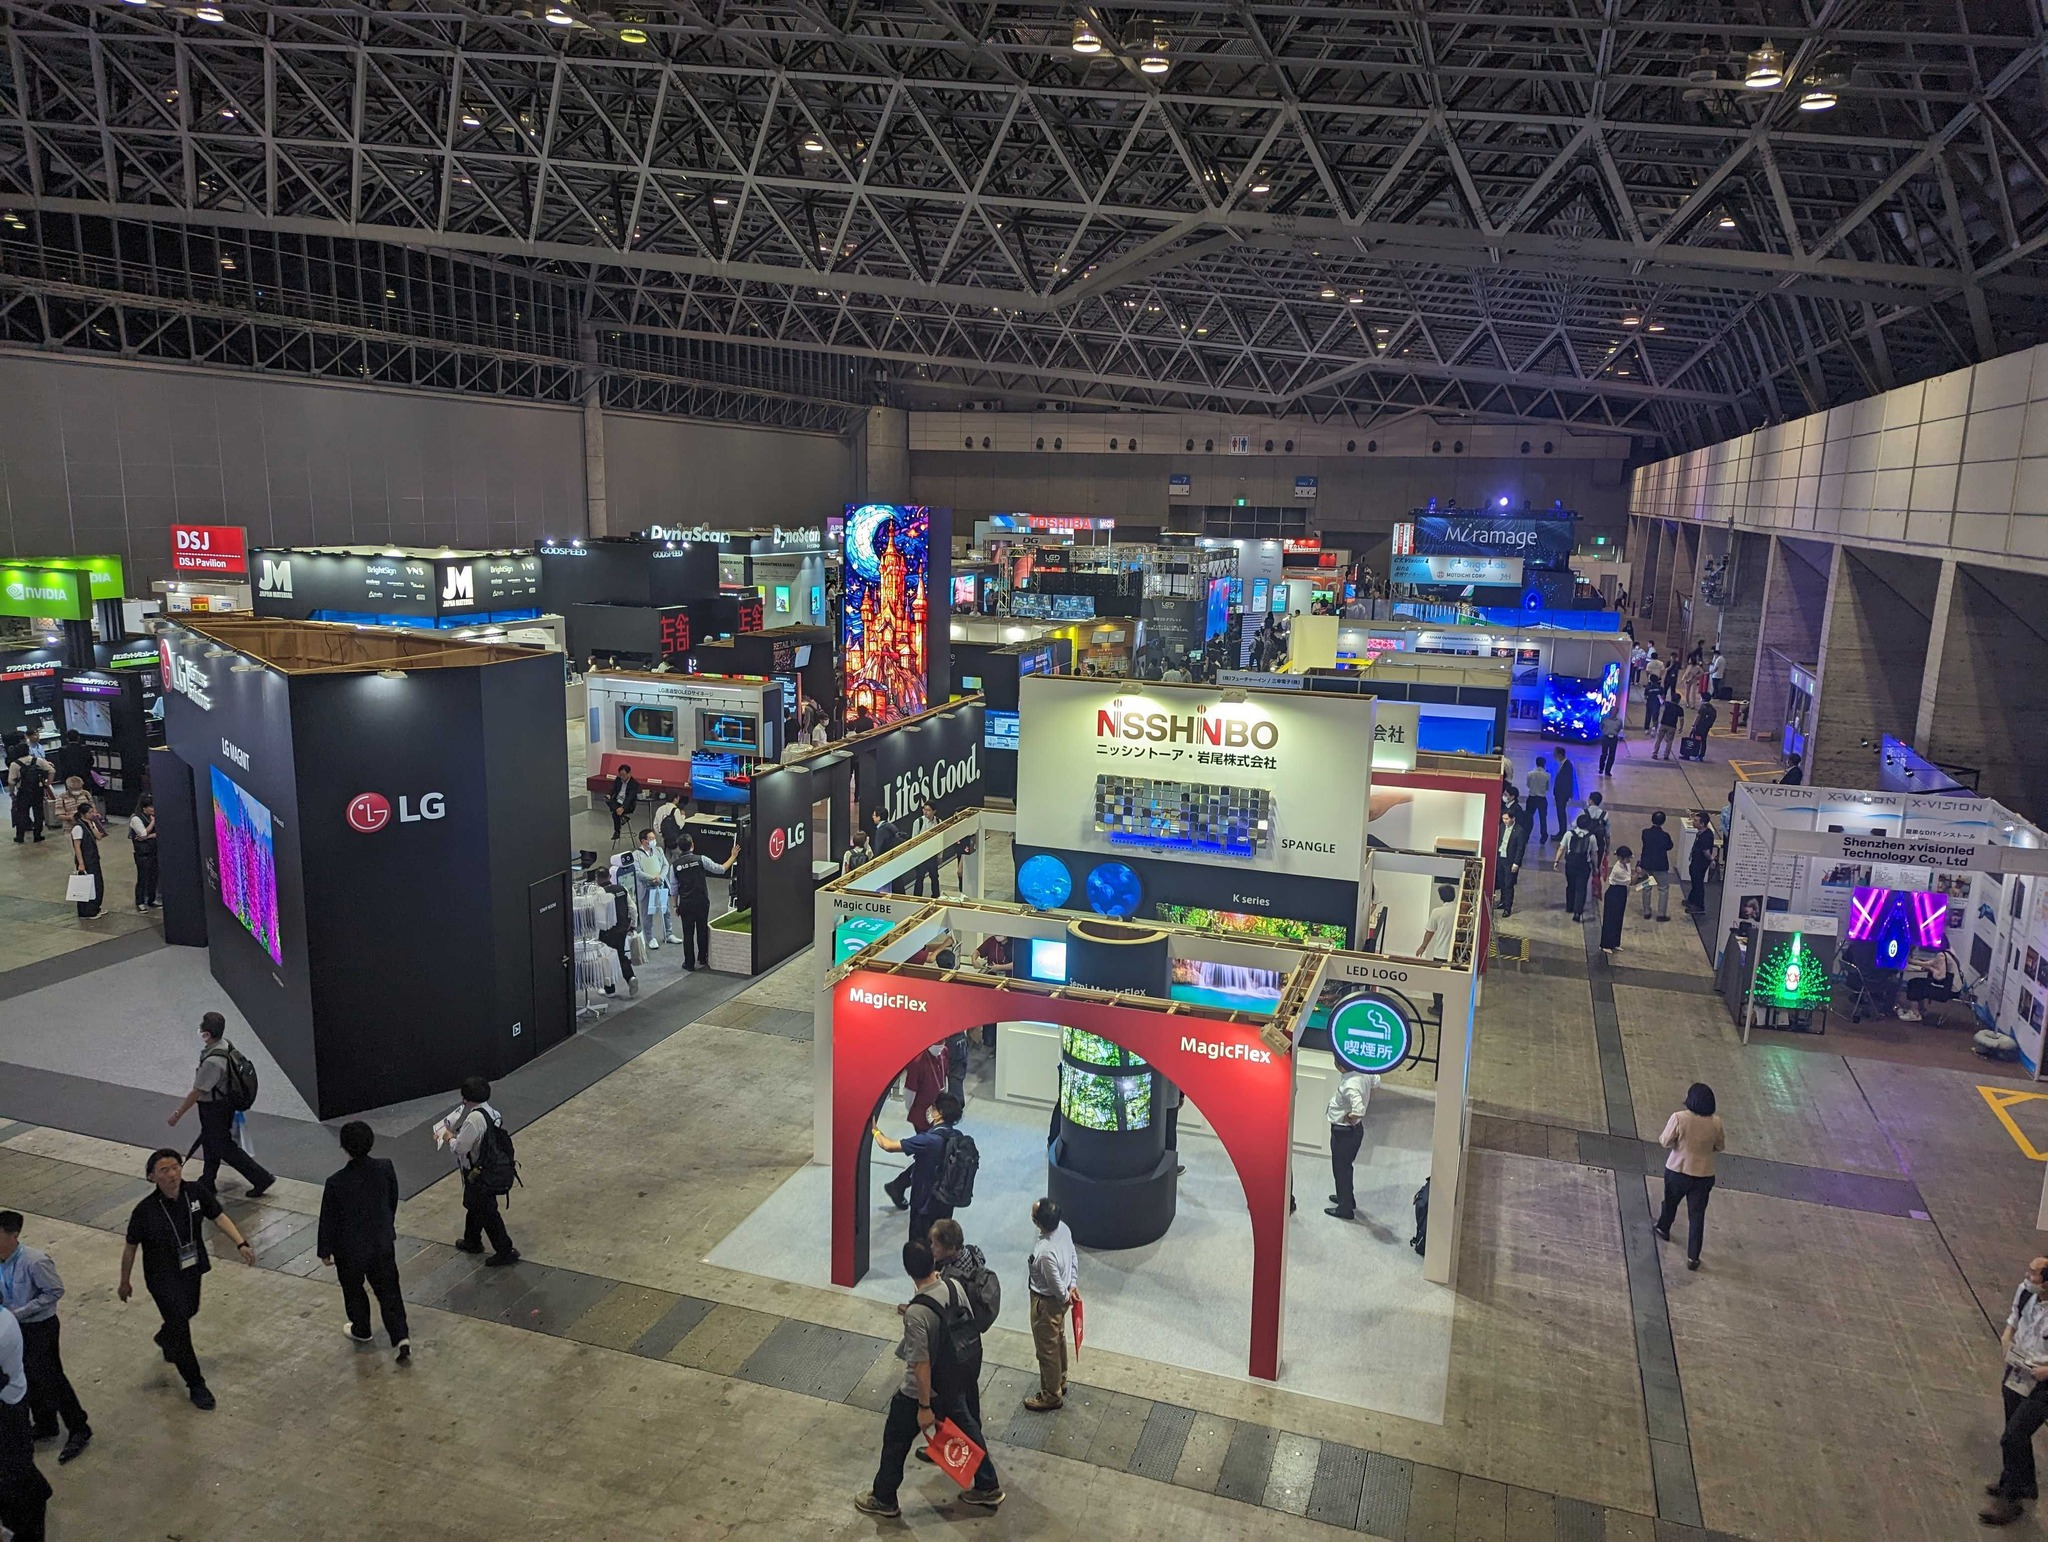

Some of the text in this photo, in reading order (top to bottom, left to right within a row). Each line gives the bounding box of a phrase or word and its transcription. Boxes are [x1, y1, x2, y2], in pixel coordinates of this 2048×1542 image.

[1030, 517, 1092, 529] TOSHIBA
[176, 530, 210, 551] DSJ
[773, 527, 821, 548] DynaScan
[1444, 523, 1538, 550] Miramage
[540, 546, 588, 556] GODSPEED
[652, 550, 684, 558] GODSPEED
[178, 558, 226, 568] DSJ Pavilion
[366, 566, 424, 576] BrightSign VNS
[490, 562, 535, 574] BrightSign VNS
[90, 573, 111, 582] DIA
[258, 560, 293, 592] JM
[442, 566, 474, 600] JM
[25, 706, 52, 715] macnica
[1374, 724, 1404, 744] 会社
[221, 736, 250, 772] LG MAGNIT
[932, 742, 980, 799] Good.
[1746, 787, 1813, 798] X-VISION
[399, 792, 445, 822] LG
[1912, 799, 1982, 813] X-VISION
[788, 822, 805, 850] LG
[1906, 828, 1976, 839] 簡単なDIYインストール
[1282, 838, 1336, 854] SPANGLE
[1843, 837, 1975, 856] Shenzhen xvisionled
[1842, 848, 1968, 866] Technology Co., Ltd
[834, 899, 891, 914] Magic CUBE
[1232, 894, 1270, 907] K series
[1346, 964, 1408, 982] LED LOGO
[1069, 977, 1088, 988] Semi
[849, 987, 928, 1012] MagicFlex
[1180, 1036, 1271, 1064] MagicFlex
[1343, 1039, 1393, 1060] 喫煙所
